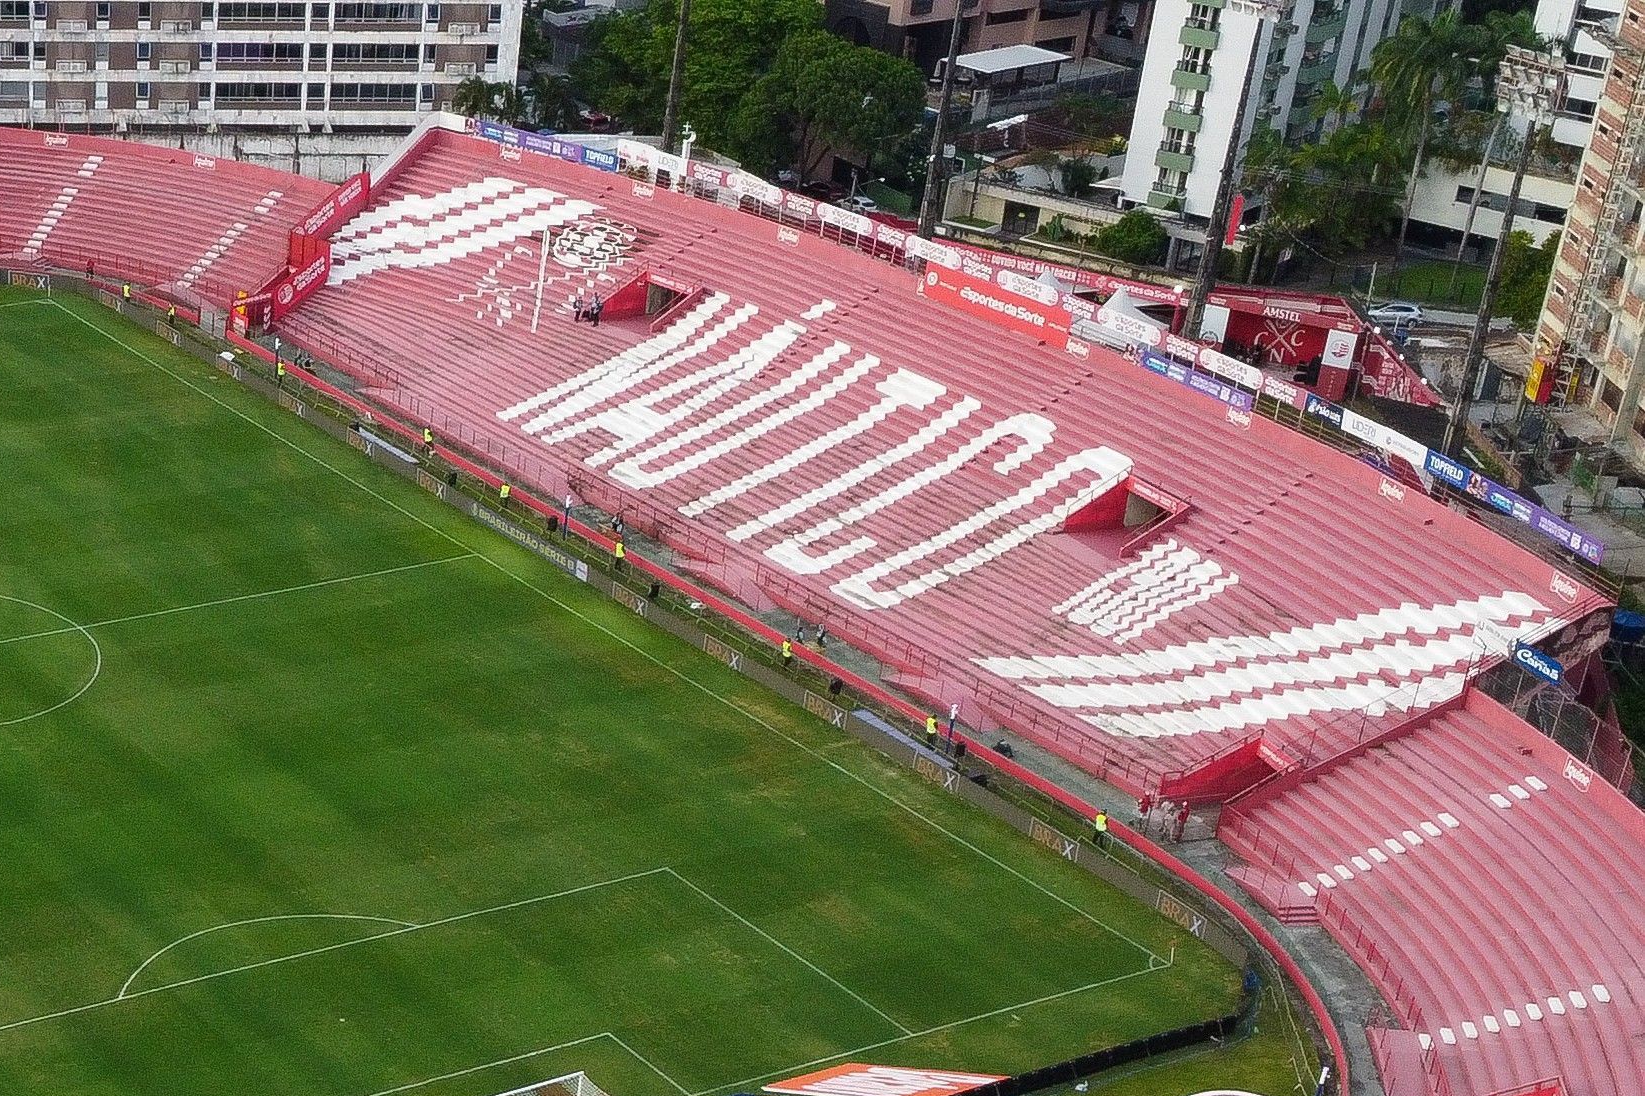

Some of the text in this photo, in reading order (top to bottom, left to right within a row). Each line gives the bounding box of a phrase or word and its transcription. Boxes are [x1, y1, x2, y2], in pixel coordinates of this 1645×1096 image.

[12, 274, 45, 287] BRAX
[1263, 306, 1301, 323] AMSTEL
[496, 291, 1133, 609] NÁUTICO
[1161, 898, 1201, 936] BRAX
